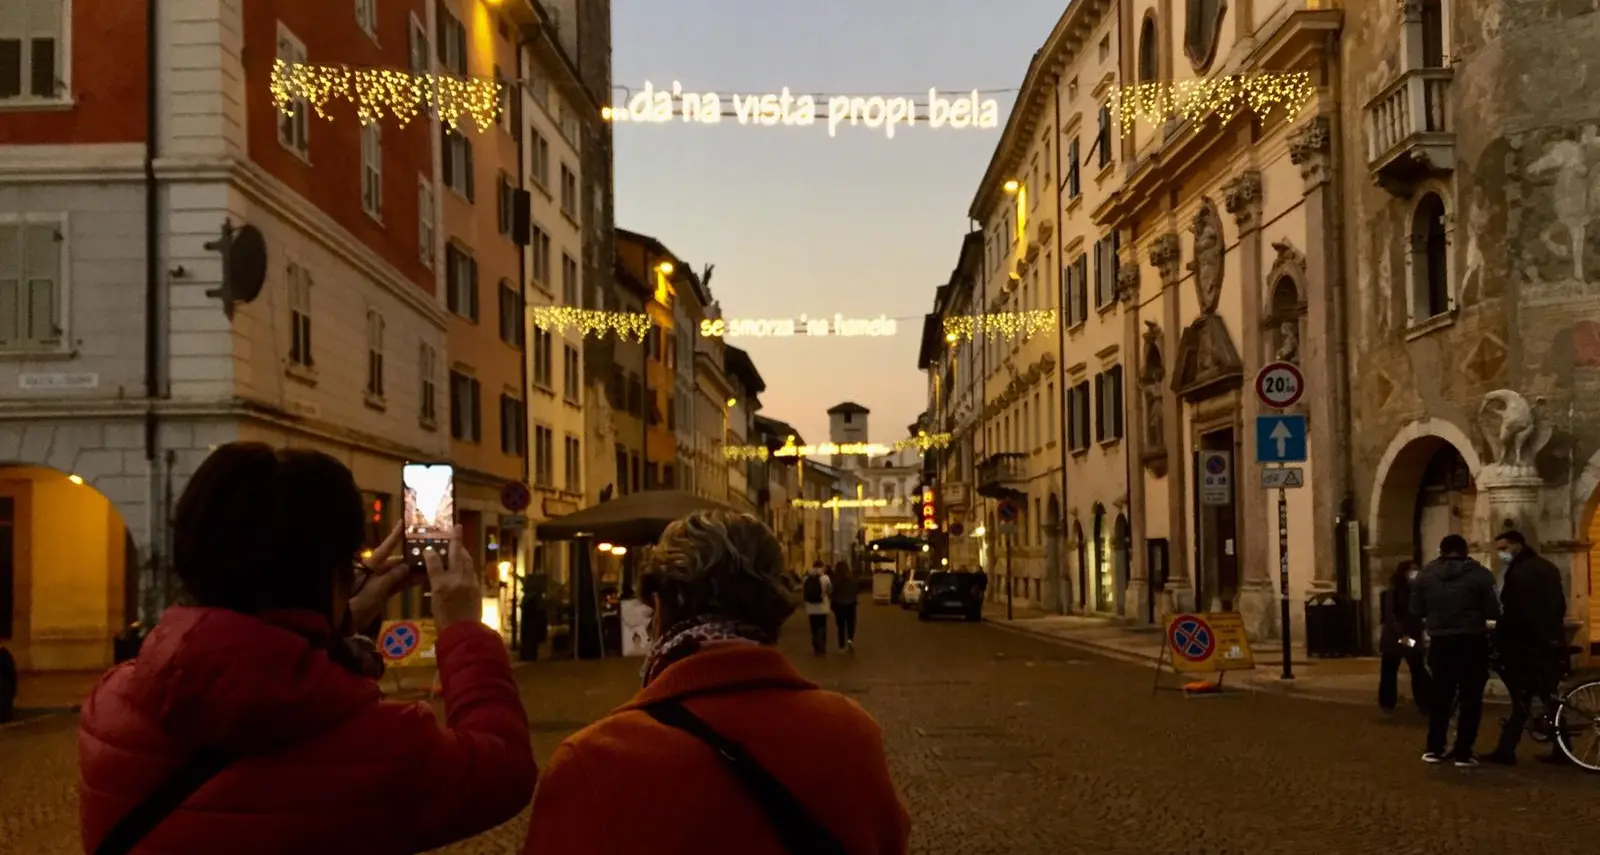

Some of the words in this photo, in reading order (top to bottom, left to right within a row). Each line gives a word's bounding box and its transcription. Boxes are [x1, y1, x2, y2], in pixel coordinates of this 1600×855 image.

[732, 86, 815, 126] vista
[826, 94, 916, 139] propi
[928, 87, 999, 129] bela
[700, 318, 724, 337] se
